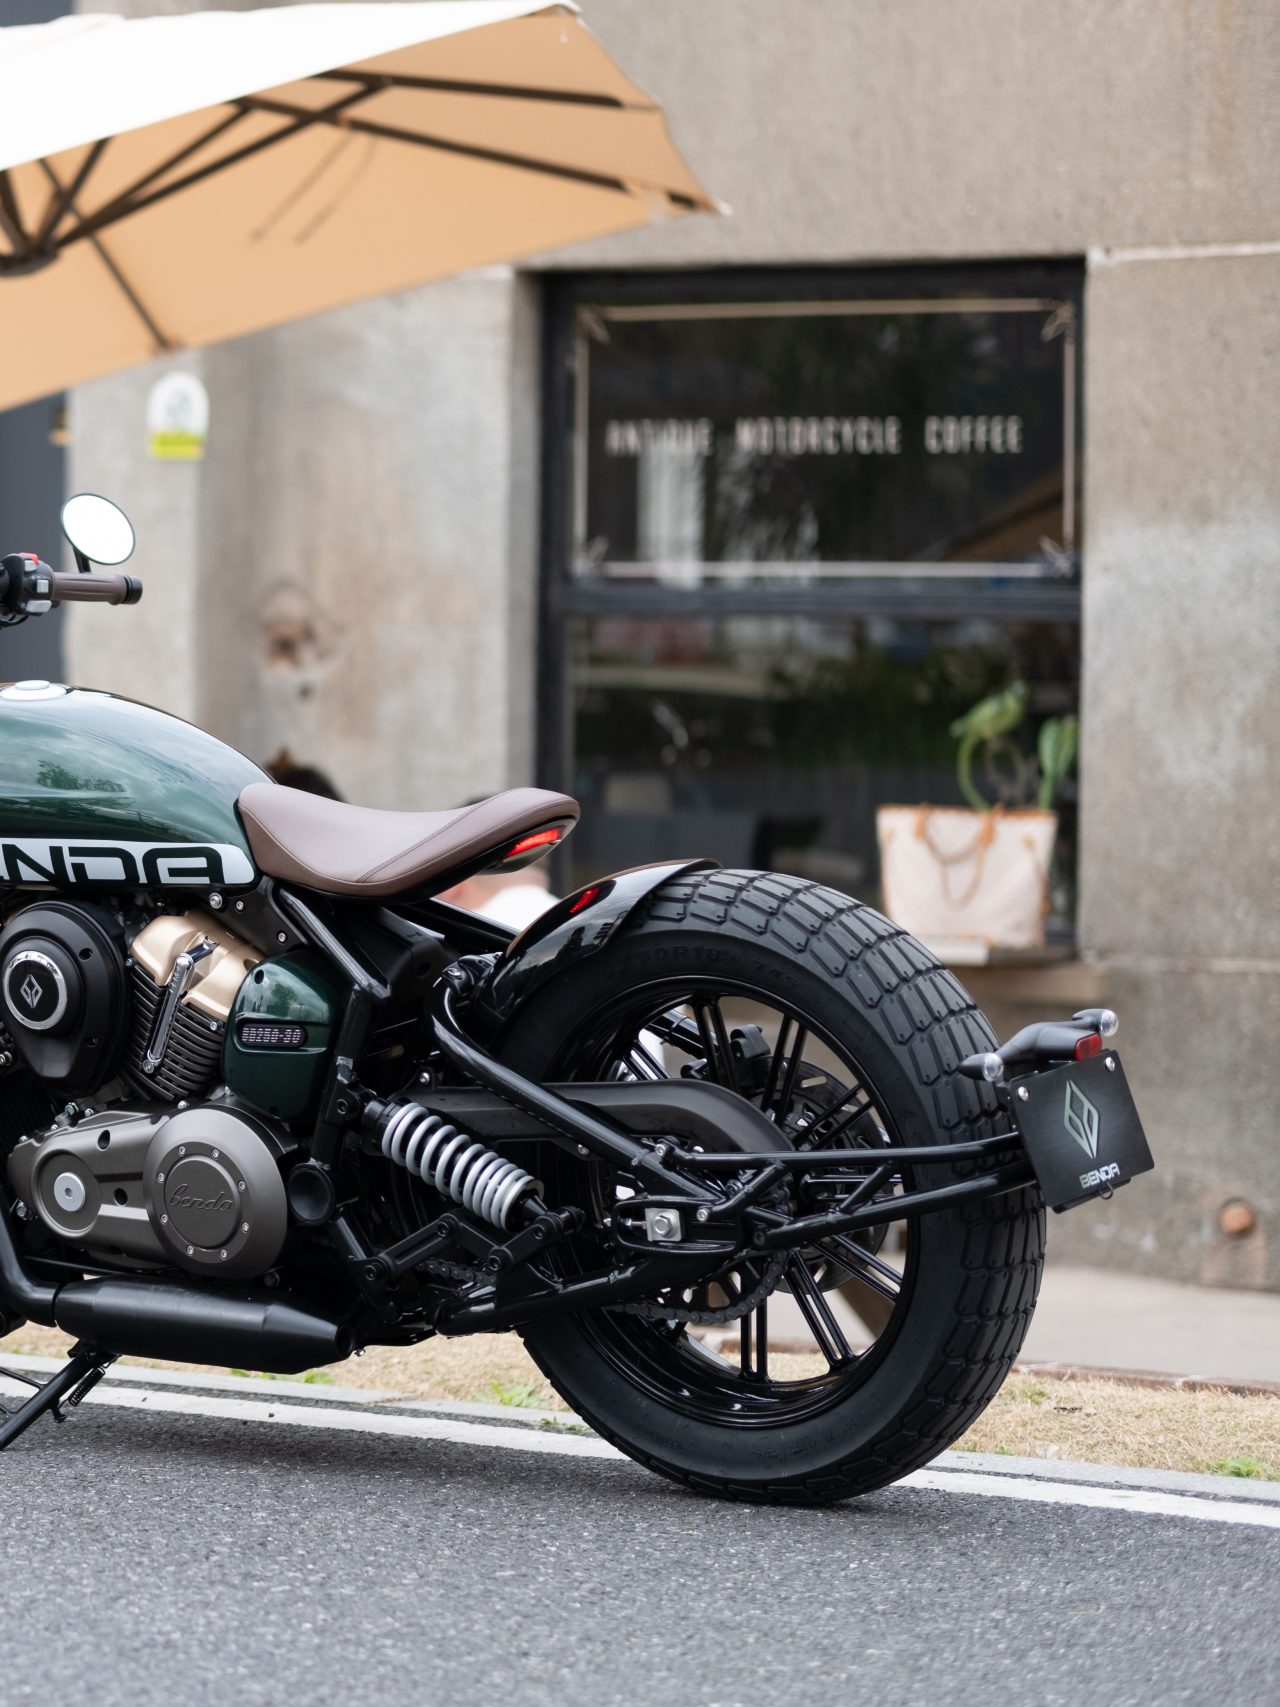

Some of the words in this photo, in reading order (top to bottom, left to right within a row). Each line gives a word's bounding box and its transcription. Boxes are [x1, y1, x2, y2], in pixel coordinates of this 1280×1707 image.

[736, 416, 902, 454] MOTORCYCLE
[925, 415, 1023, 454] COFFEE
[1080, 1162, 1120, 1188] BENDA
